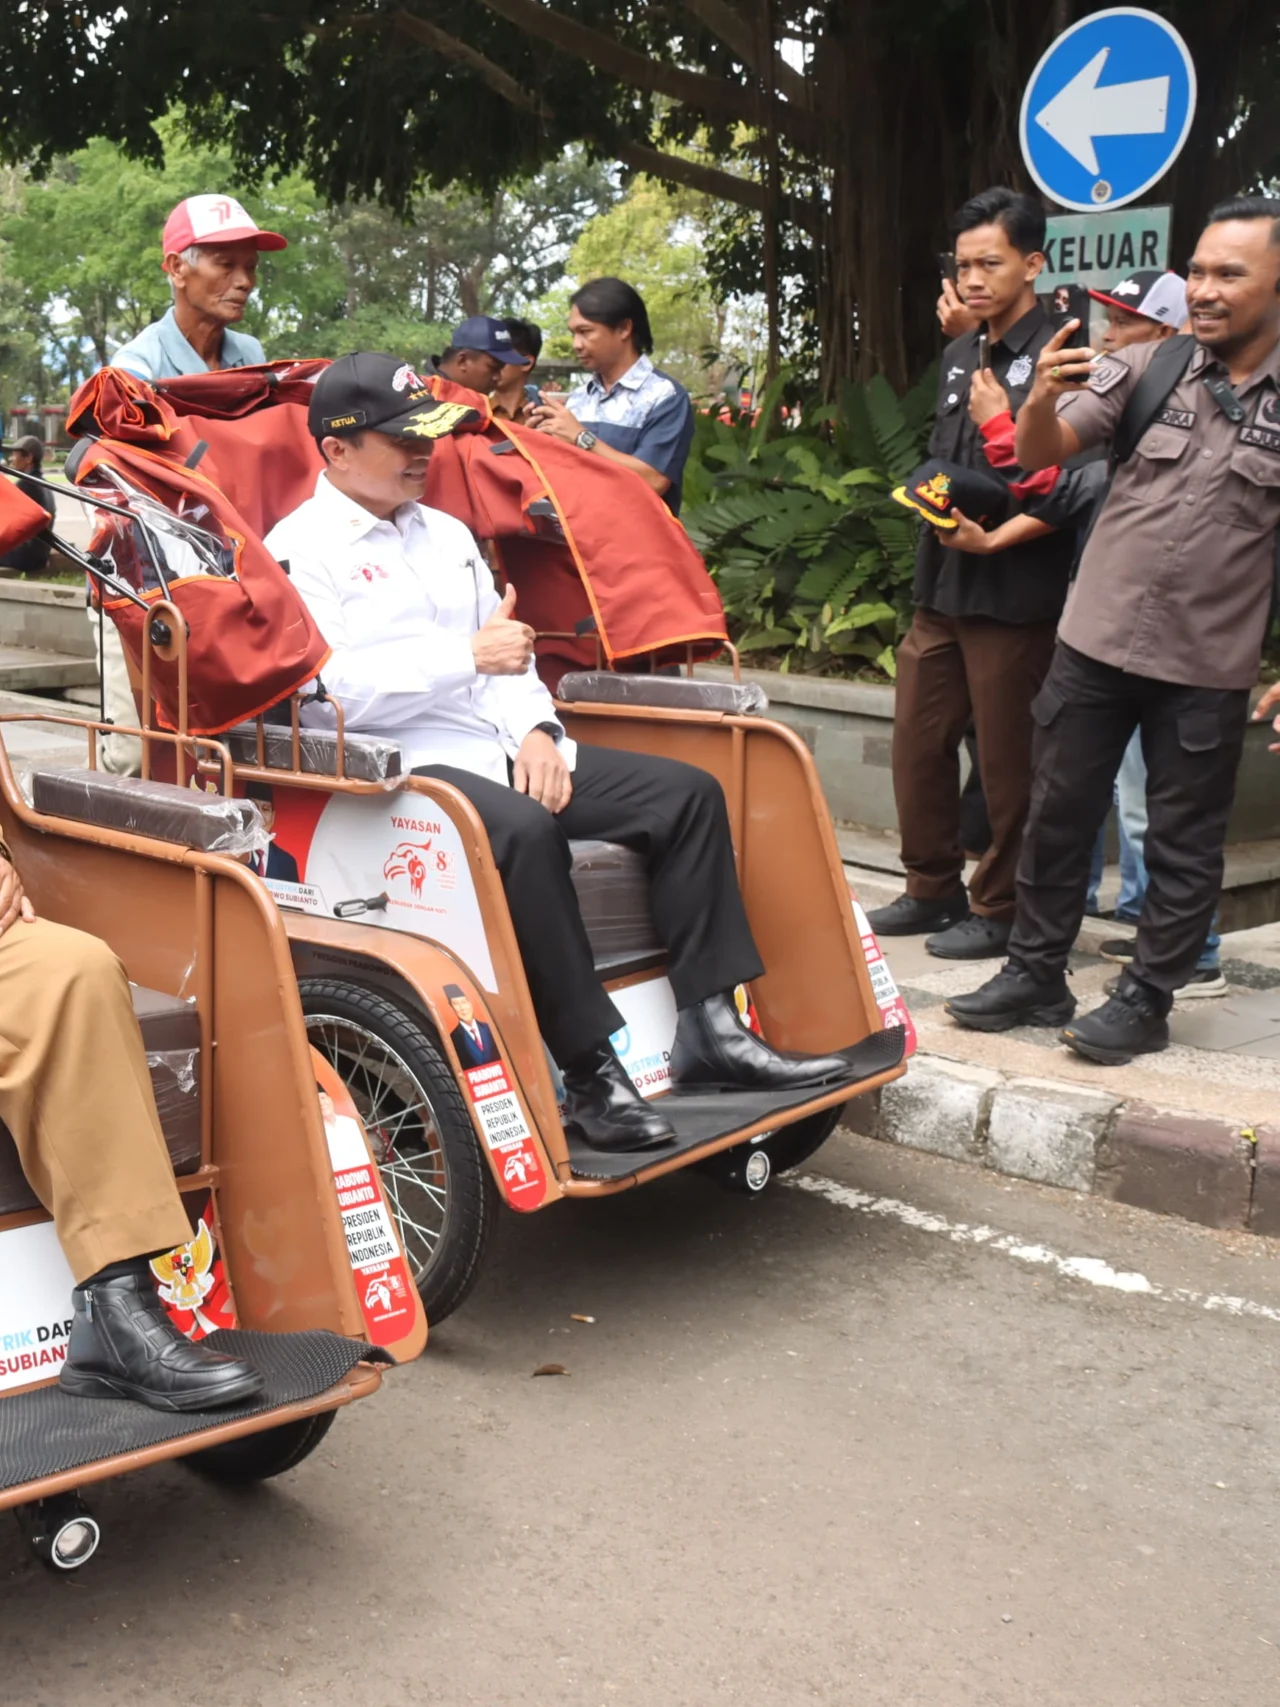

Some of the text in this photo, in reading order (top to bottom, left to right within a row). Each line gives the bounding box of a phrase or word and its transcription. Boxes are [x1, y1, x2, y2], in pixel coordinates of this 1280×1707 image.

[1043, 230, 1159, 274] KELUAR
[331, 416, 357, 428] KETUA
[390, 816, 441, 835] YAYASAN
[285, 893, 318, 906] SUBIANTO
[298, 887, 314, 897] DARI
[481, 1097, 514, 1116] PRESIDEN
[486, 1111, 519, 1130] REPUBLIK
[489, 1124, 526, 1145] INDONESIA
[342, 1208, 381, 1229] PRESIDEN
[346, 1225, 387, 1247] REPUBLIK
[350, 1241, 394, 1264] INDONESIA
